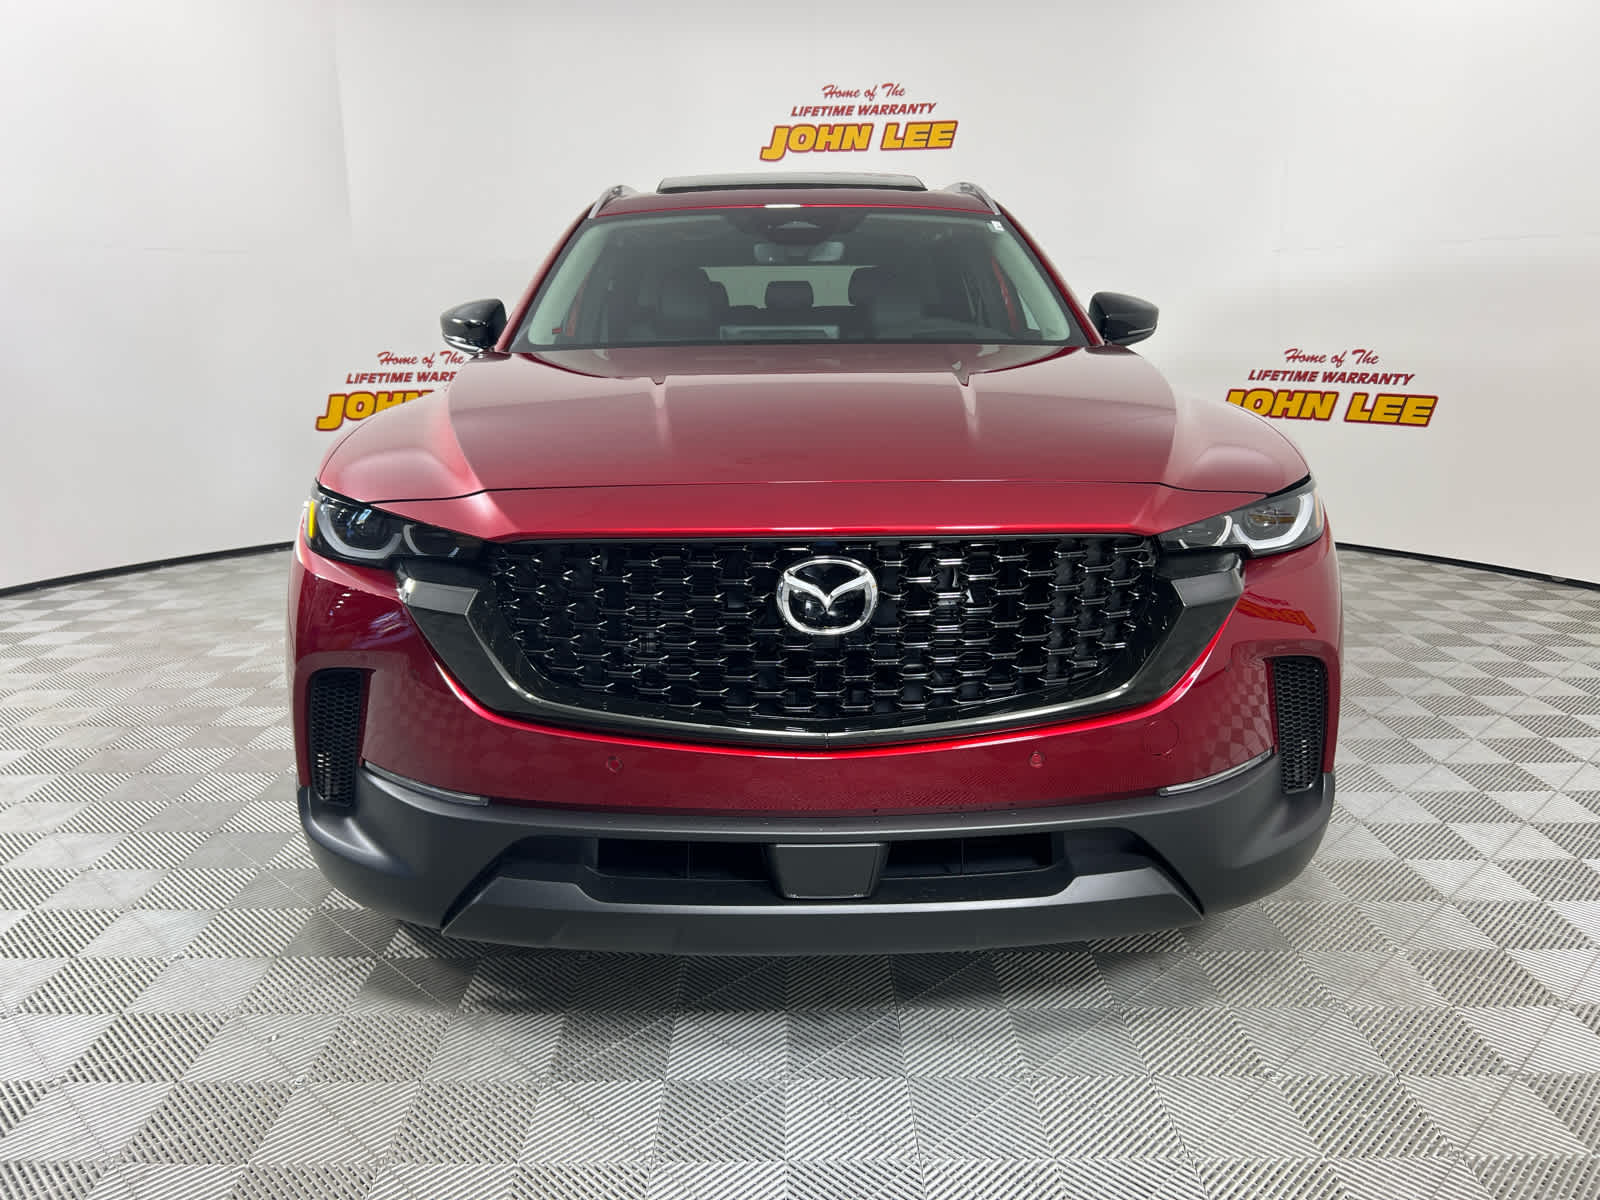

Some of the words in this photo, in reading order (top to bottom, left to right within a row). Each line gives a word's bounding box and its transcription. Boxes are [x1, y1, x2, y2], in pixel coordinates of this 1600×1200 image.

[822, 84, 860, 98] Home
[864, 85, 877, 100] of
[881, 83, 905, 97] The
[791, 105, 854, 117] LIFETIME
[858, 103, 936, 115] WARRANTY
[760, 123, 874, 162] JOHN
[880, 120, 958, 151] LEE
[377, 351, 418, 365] Home
[422, 352, 435, 368] of
[440, 350, 464, 365] The
[1284, 348, 1327, 364] Home
[1331, 350, 1346, 367] of
[1351, 349, 1379, 364] The
[346, 372, 413, 384] LIFETIME
[1248, 370, 1318, 382] LIFETIME
[1321, 371, 1415, 386] WARRANTY
[315, 389, 435, 431] JOH
[1344, 392, 1438, 427] LEE
